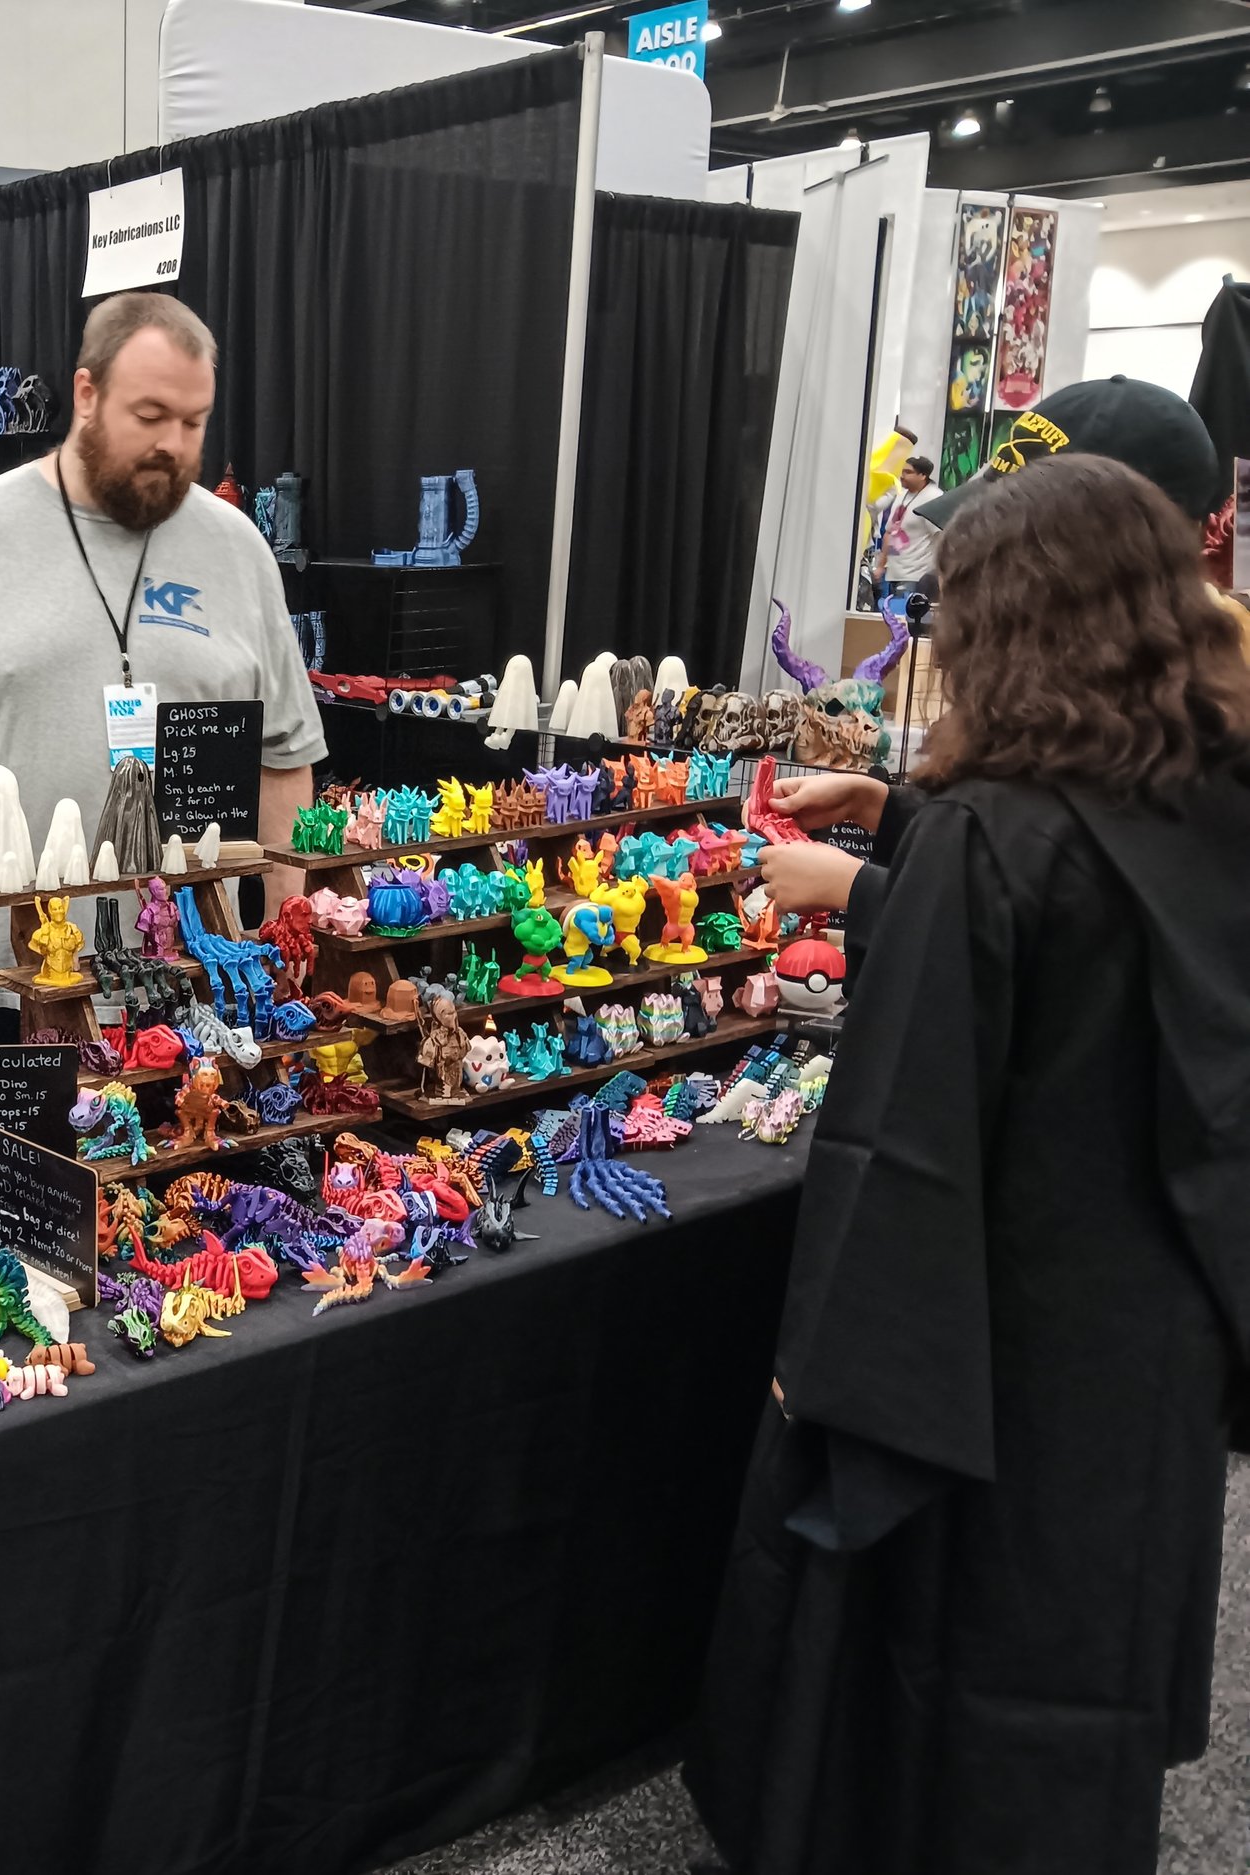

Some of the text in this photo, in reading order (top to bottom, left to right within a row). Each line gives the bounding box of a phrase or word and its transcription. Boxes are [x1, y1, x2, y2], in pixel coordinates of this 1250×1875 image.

[635, 16, 698, 54] AISLE
[92, 214, 180, 249] Key Fabrications LLC
[156, 259, 177, 275] 4208
[169, 706, 219, 721] GHOSTS
[202, 725, 219, 735] me
[225, 717, 246, 738] up!
[183, 765, 194, 775] 15
[187, 784, 194, 794] 6
[197, 783, 221, 794] each
[175, 796, 216, 807] 2 for 10
[162, 808, 248, 822] We Glow in the
[831, 824, 839, 834] 6
[841, 826, 865, 836] each
[0, 1079, 28, 1089] Dino
[36, 1090, 48, 1100] 15
[2, 1138, 41, 1166] SALE!
[14, 1169, 28, 1184] you
[29, 1174, 45, 1196] buy
[48, 1186, 82, 1214] anything
[23, 1207, 41, 1231] bag
[45, 1221, 53, 1231] of
[56, 1227, 81, 1244] dice!
[16, 1227, 27, 1243] 2
[30, 1234, 52, 1254] items
[66, 1254, 75, 1263] or
[75, 1258, 93, 1274] more
